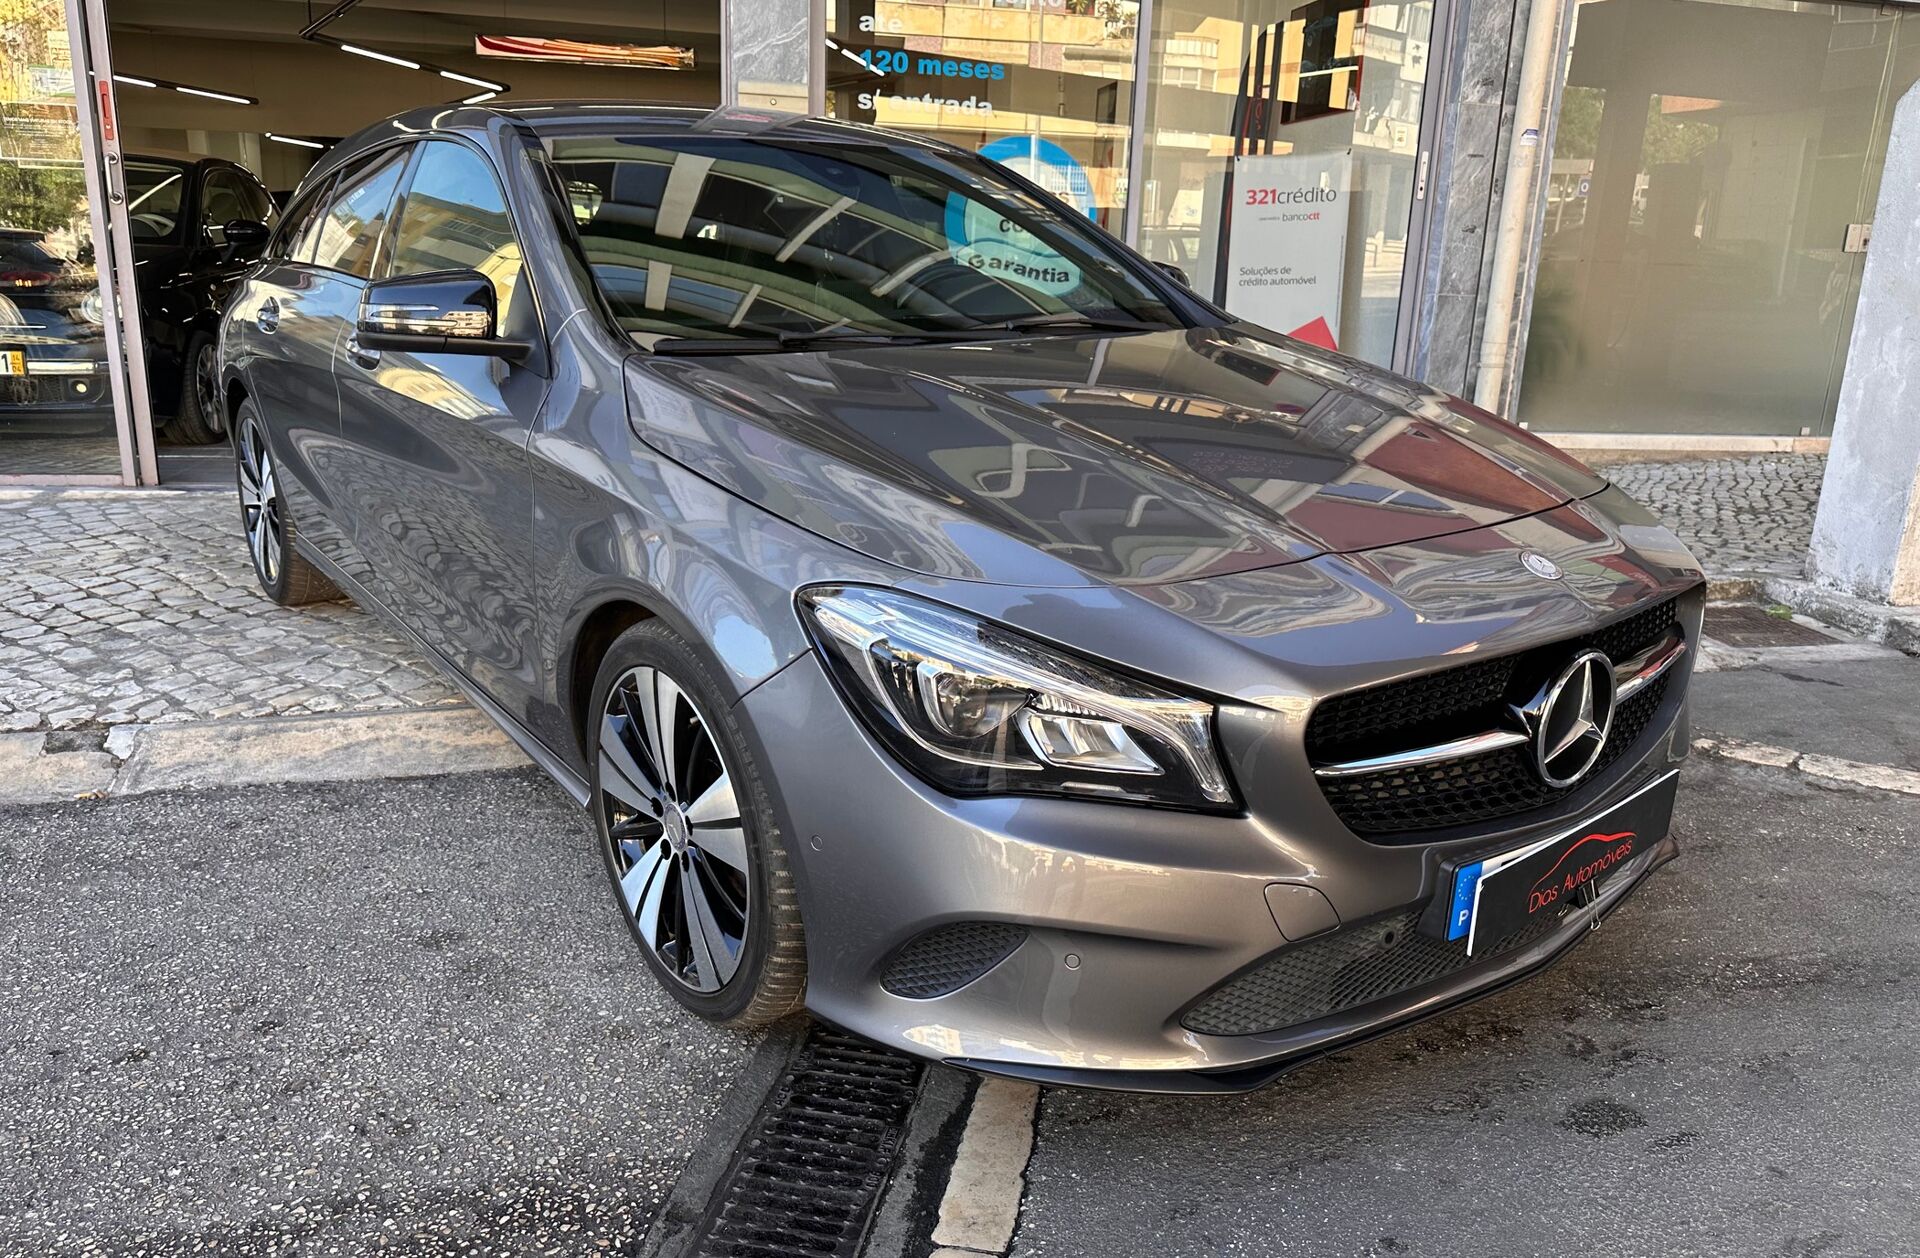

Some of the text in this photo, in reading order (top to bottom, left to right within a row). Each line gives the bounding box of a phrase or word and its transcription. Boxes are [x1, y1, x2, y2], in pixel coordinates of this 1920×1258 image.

[860, 49, 1005, 81] 120 meses
[889, 92, 993, 117] entrada
[1240, 266, 1292, 276] Soluções de
[1239, 276, 1317, 287] crédito automóvel
[1458, 910, 1469, 926] P
